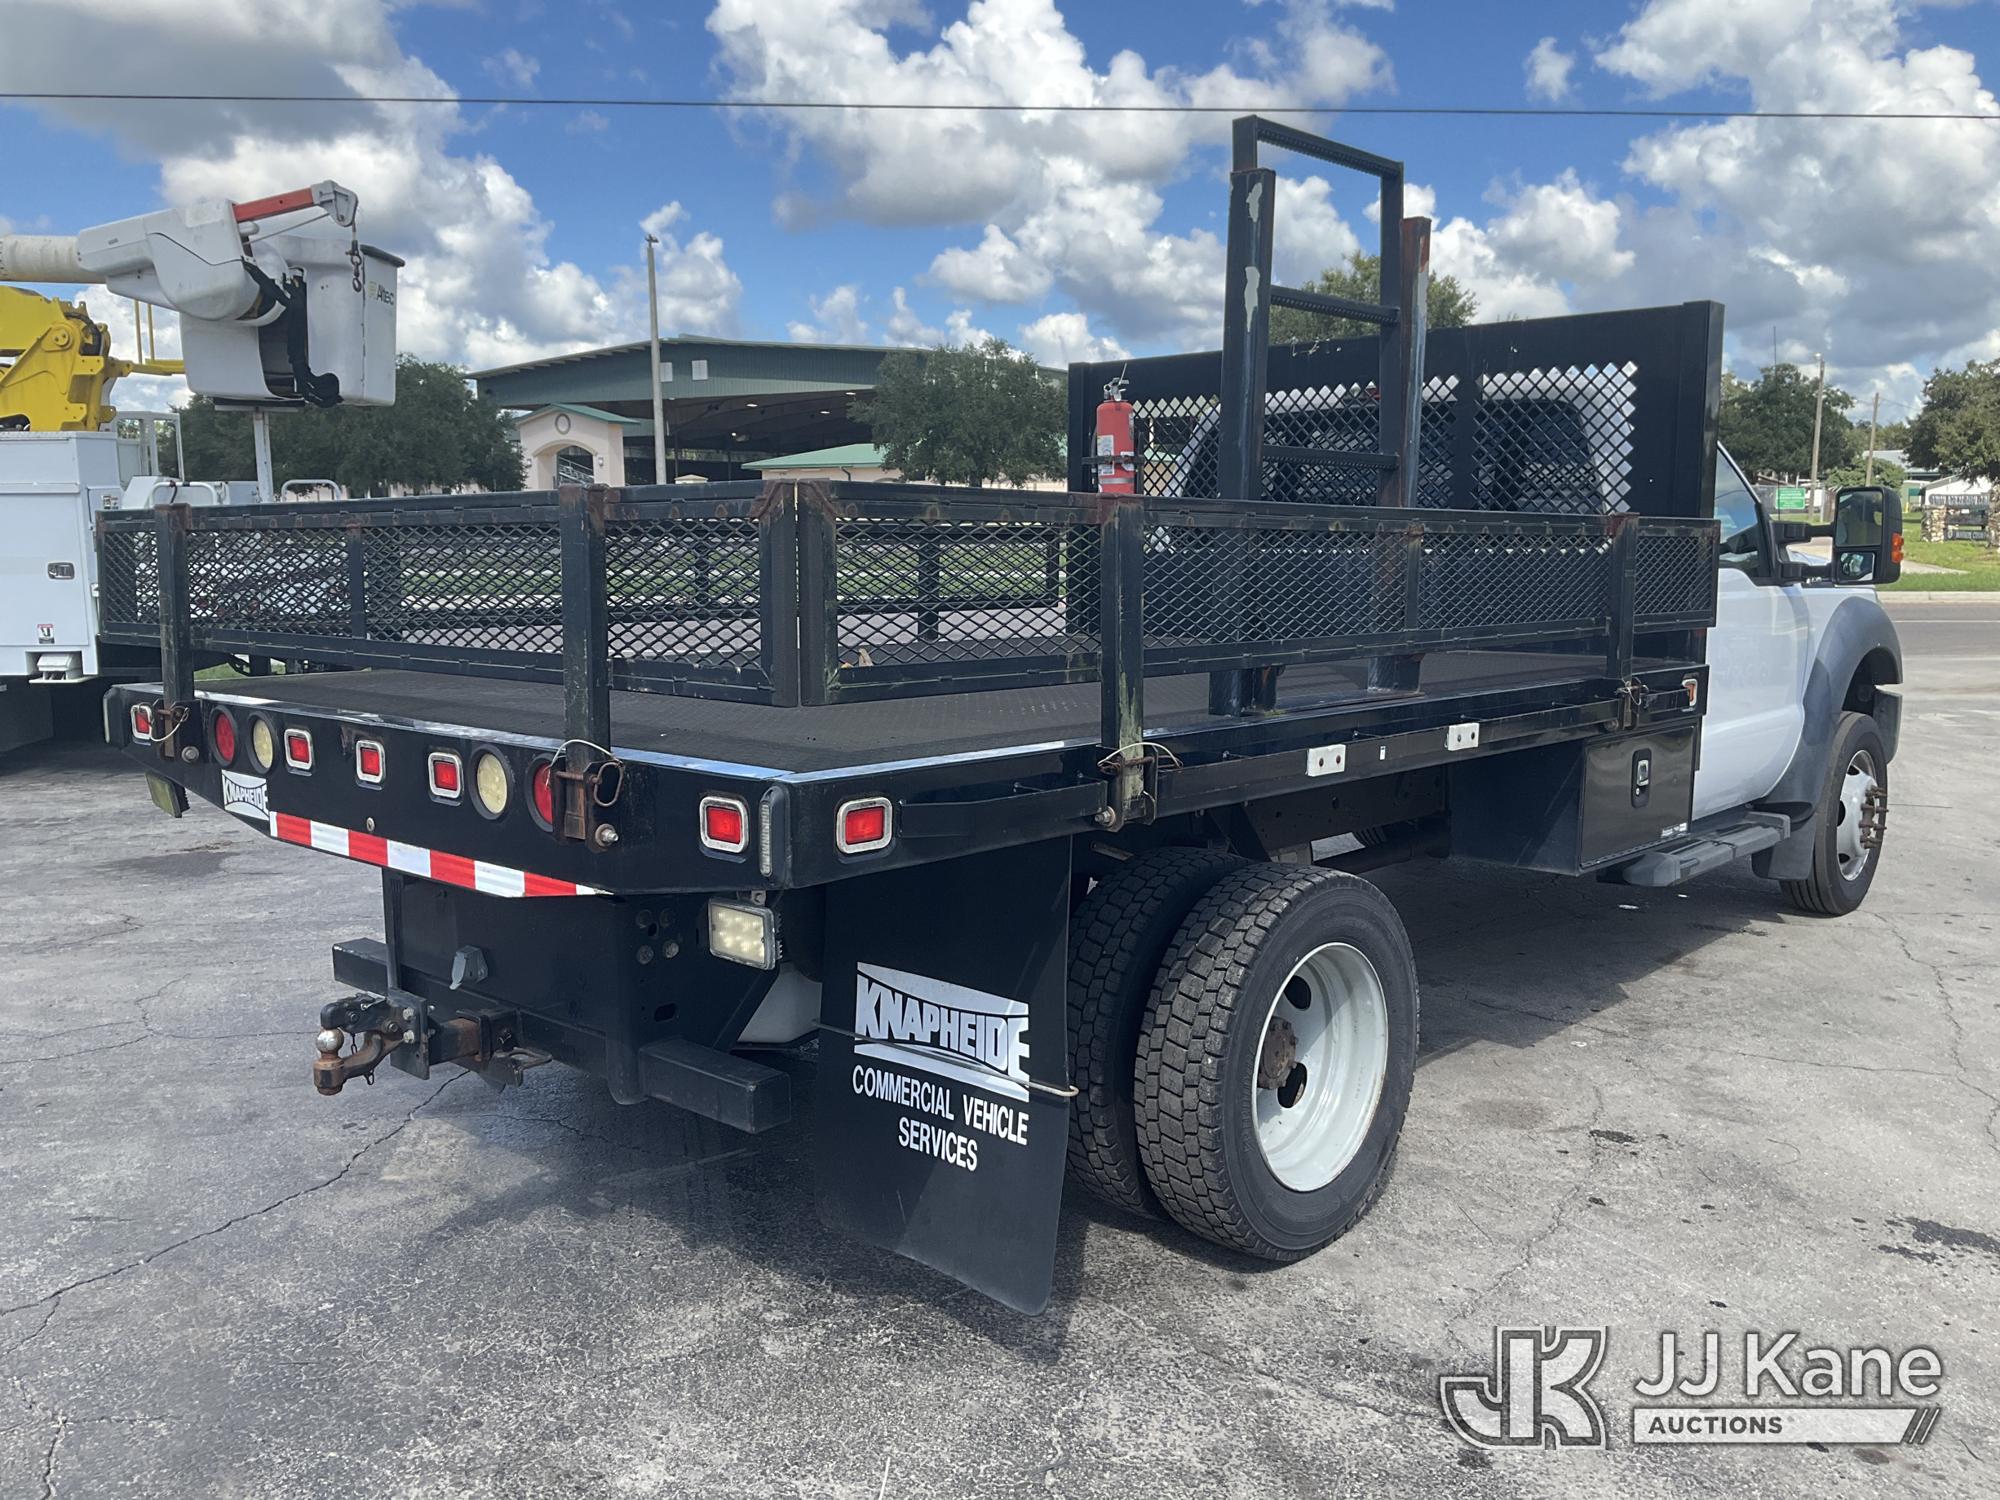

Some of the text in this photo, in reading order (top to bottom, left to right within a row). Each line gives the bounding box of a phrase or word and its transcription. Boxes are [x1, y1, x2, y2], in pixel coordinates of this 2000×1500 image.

[222, 774, 270, 815] KNAPHEIDE
[855, 973, 1030, 1088] KNAPHEIDE
[852, 1065, 1029, 1146] COMMERCIAL VEHICLE
[898, 1116, 978, 1172] SERVICES
